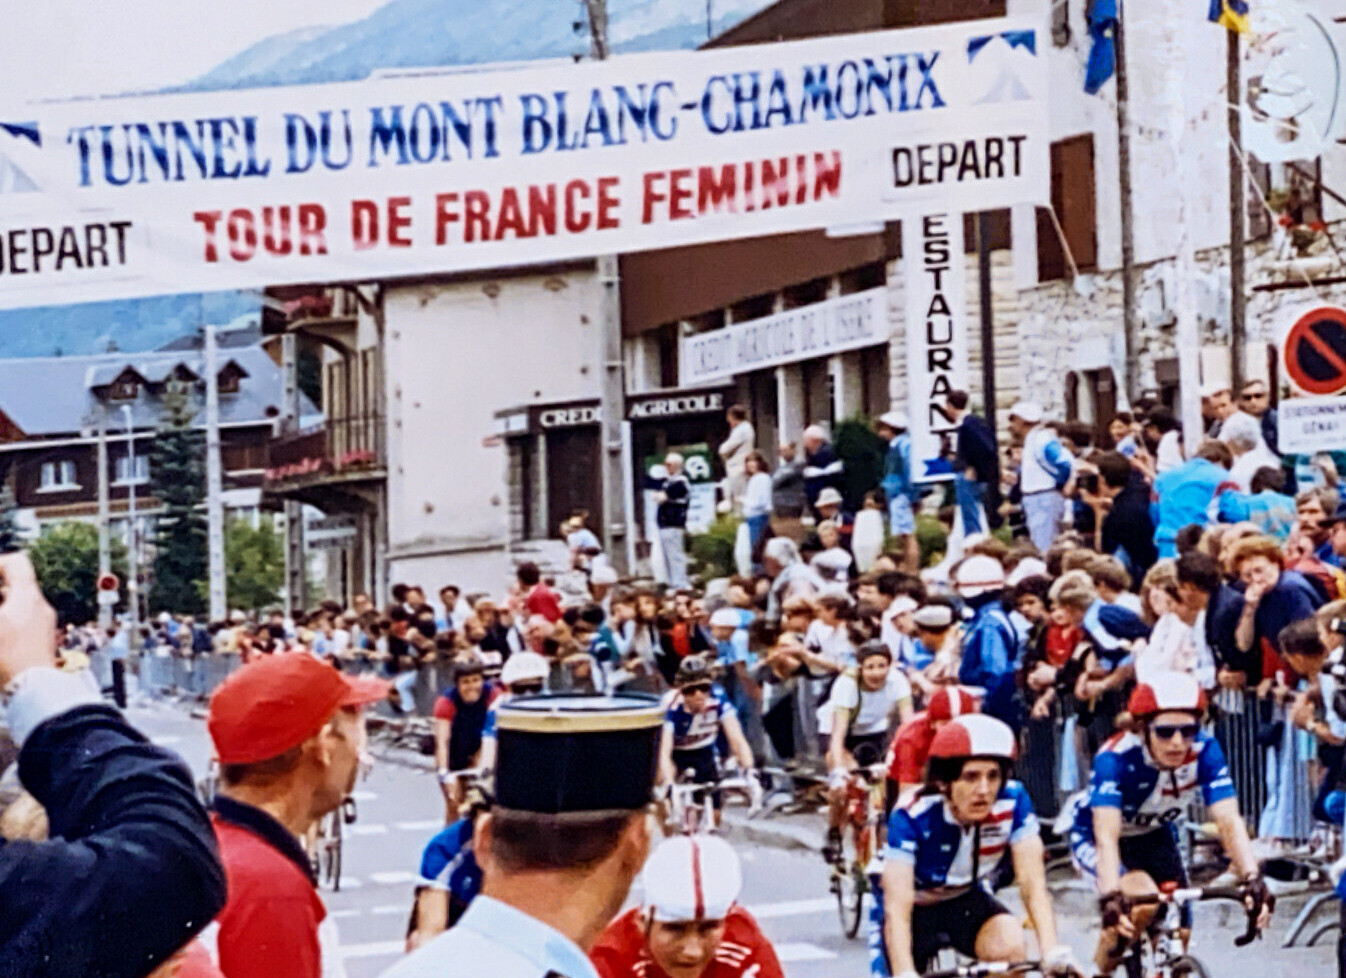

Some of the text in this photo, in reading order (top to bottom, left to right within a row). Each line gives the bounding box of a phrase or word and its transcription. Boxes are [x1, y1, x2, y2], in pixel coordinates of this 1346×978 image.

[67, 50, 946, 187] TUNNEL DU MONT BLANC-CHAMONIX
[892, 134, 1028, 188] DEPART
[193, 149, 842, 263] TOUR DE FRANCE FEMININ
[922, 213, 960, 458] ESTAURANT
[540, 394, 723, 428] CREDI AGRICOLE
